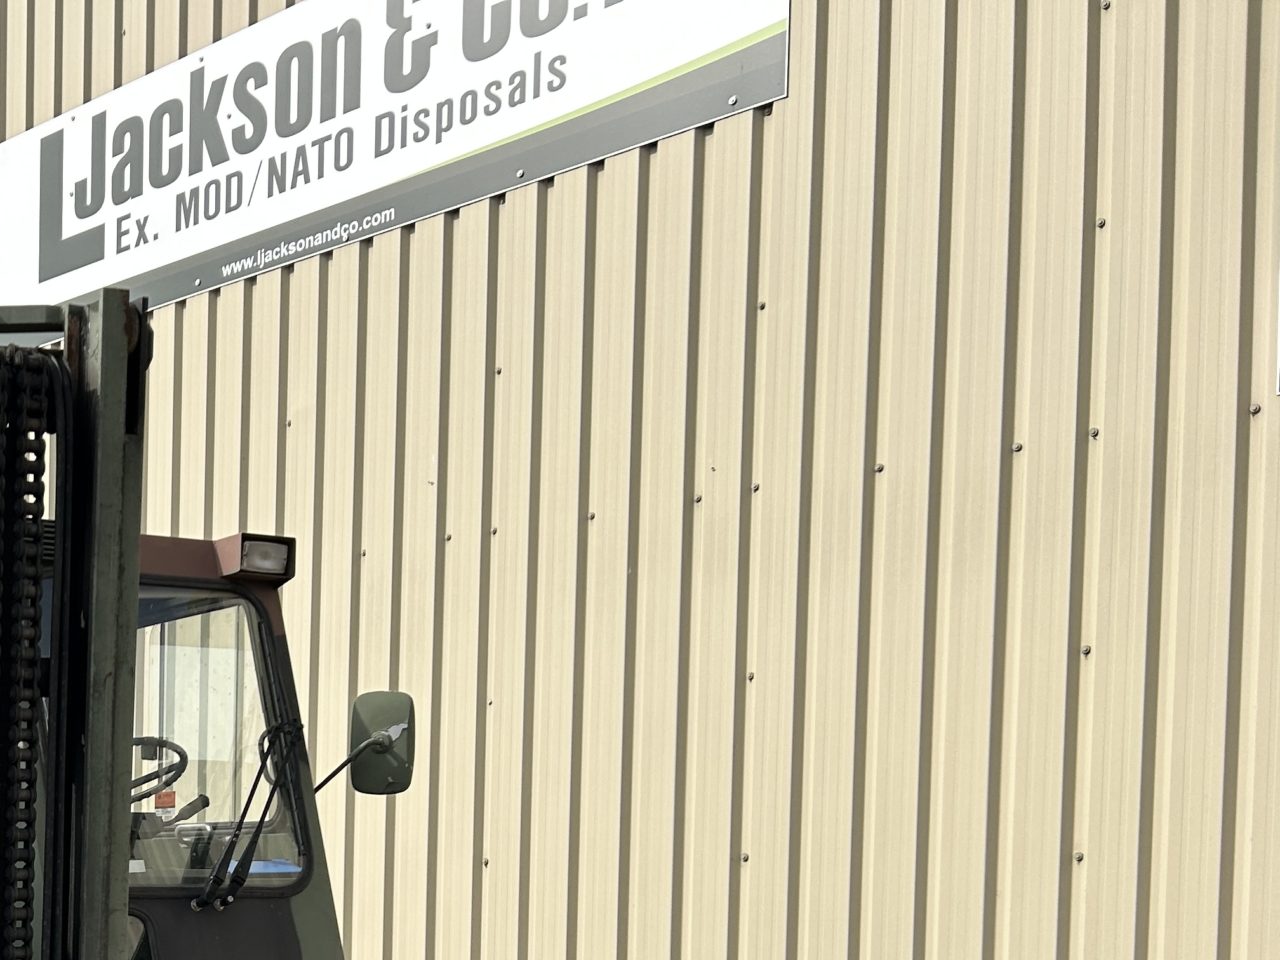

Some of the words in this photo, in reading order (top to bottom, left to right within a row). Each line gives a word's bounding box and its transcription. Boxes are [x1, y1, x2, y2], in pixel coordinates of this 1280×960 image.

[383, 0, 439, 94] &
[116, 213, 159, 255] Ex.
[175, 127, 355, 233] MOD/NATO
[374, 51, 567, 159] Disposals
[221, 208, 396, 277] www.ljacksonandco.com
